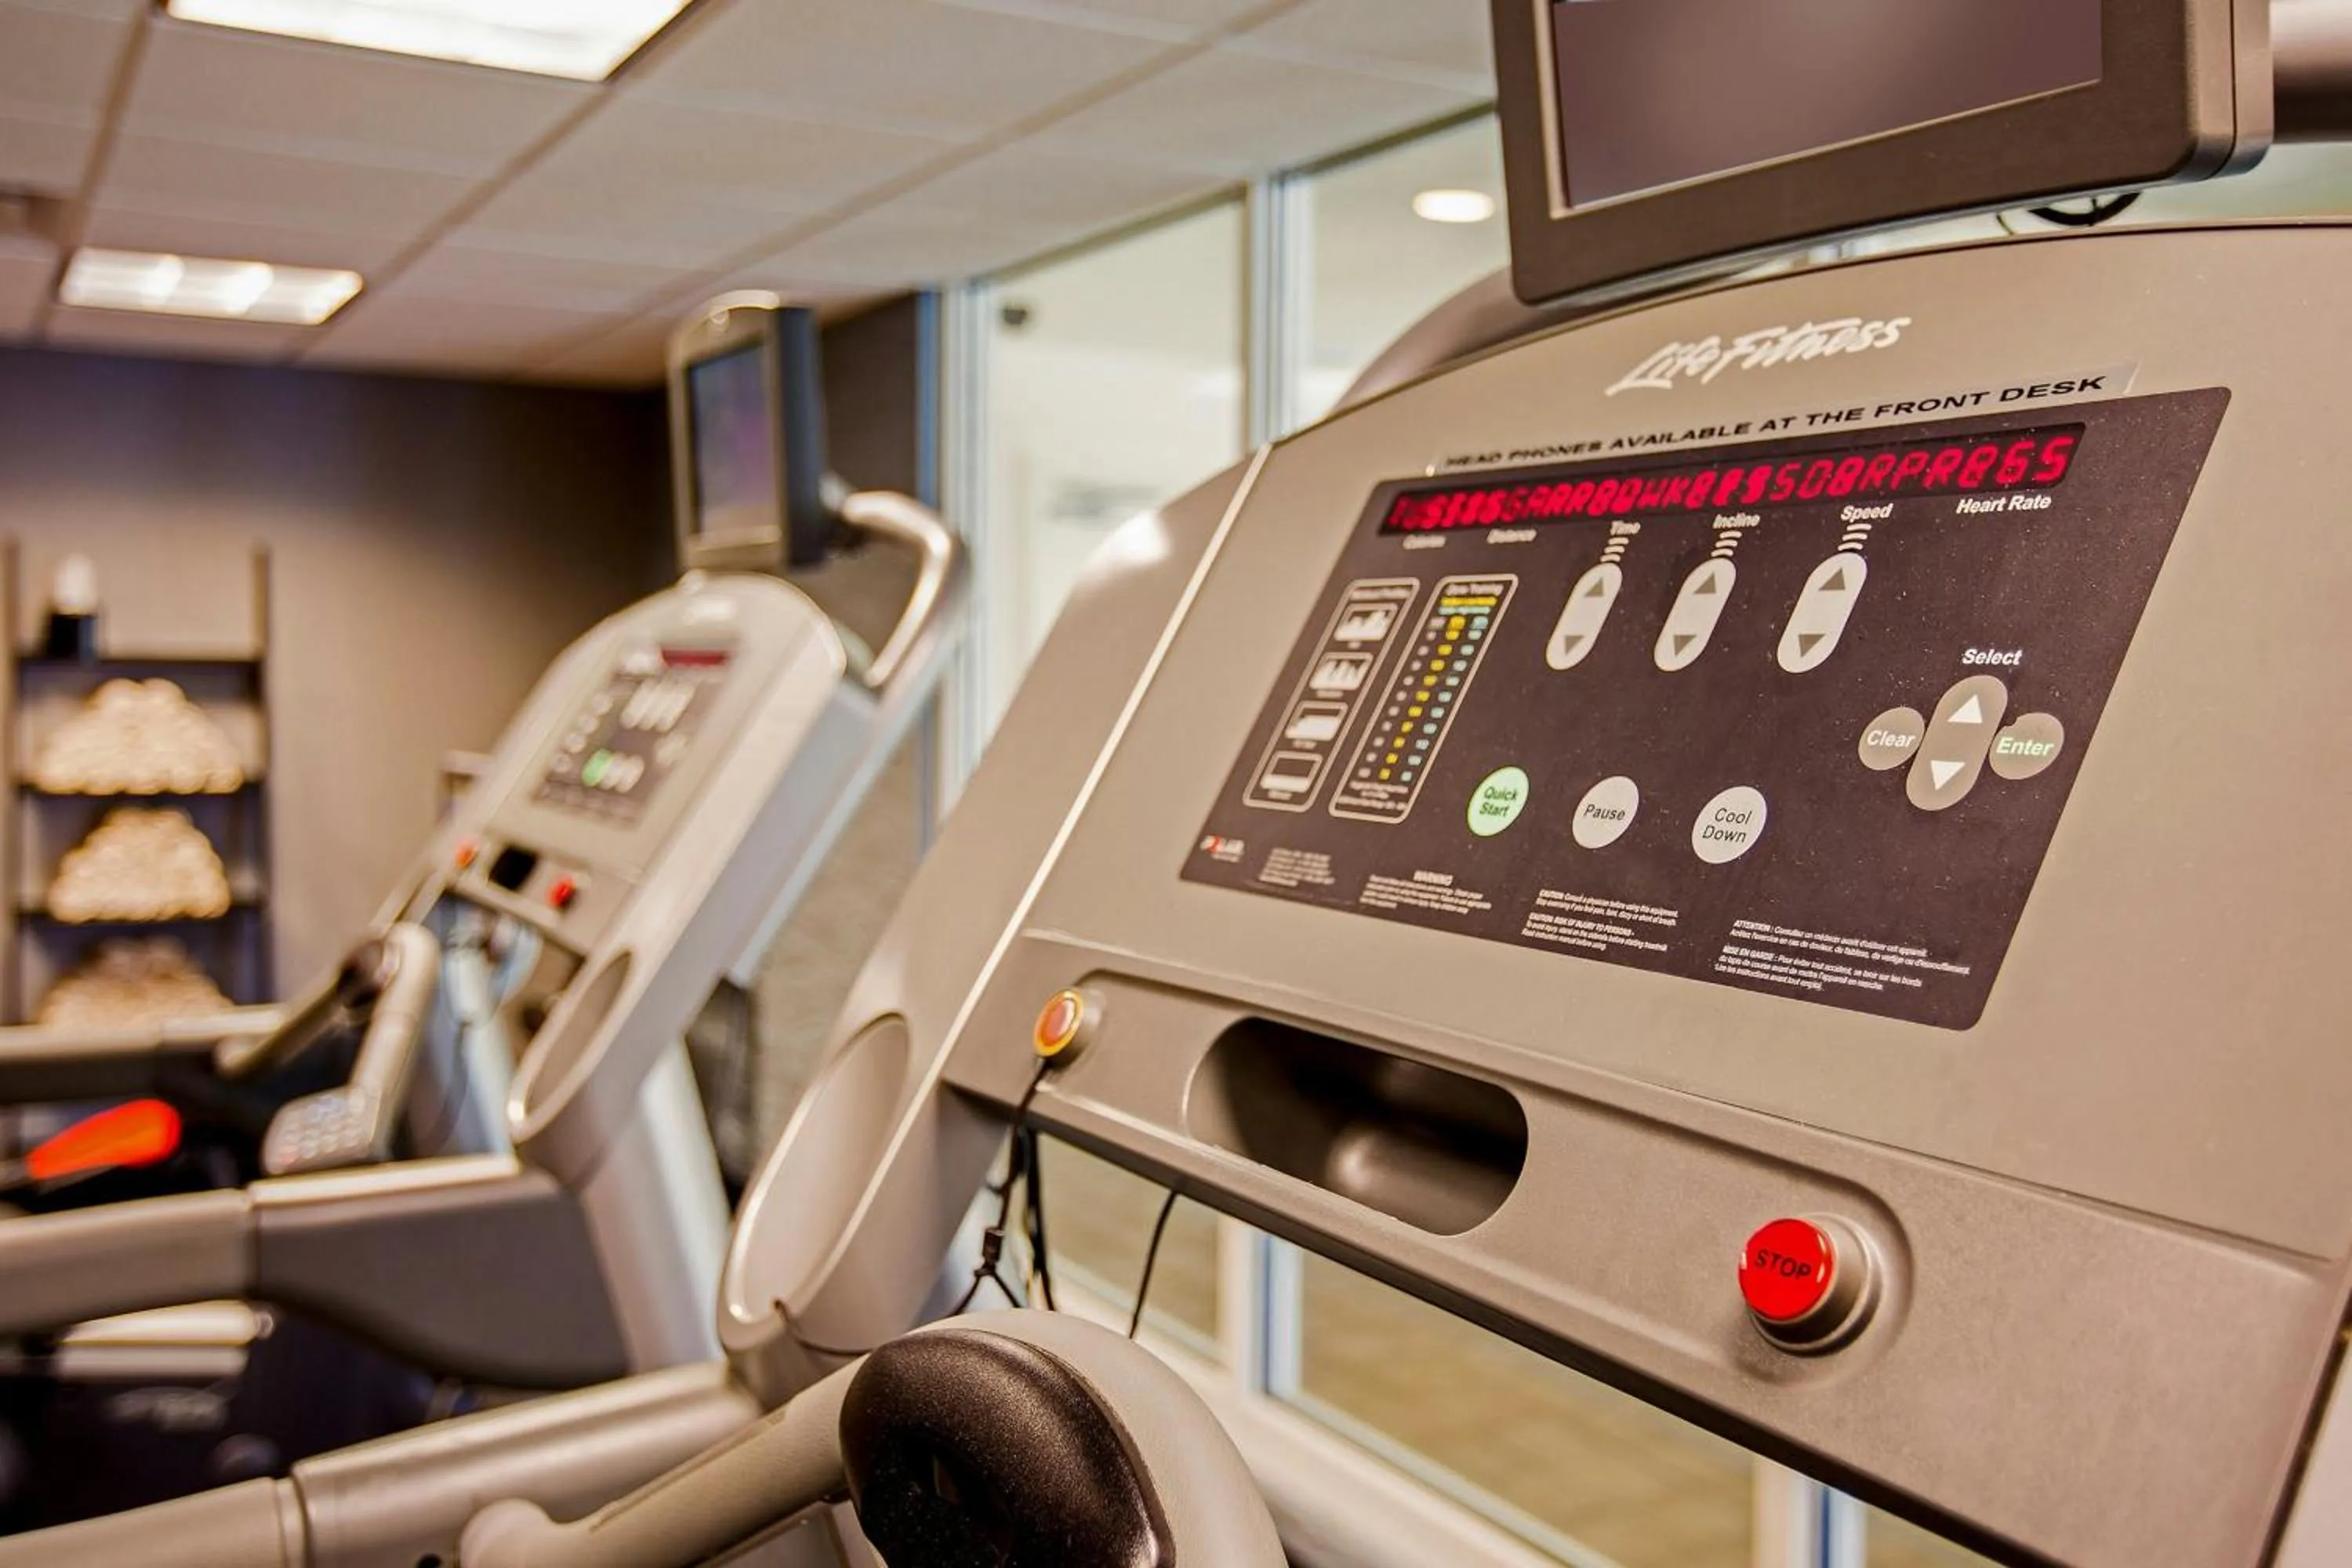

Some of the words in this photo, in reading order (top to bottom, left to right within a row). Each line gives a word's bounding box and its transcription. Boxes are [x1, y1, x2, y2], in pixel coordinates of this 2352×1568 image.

[1508, 441, 1602, 461] PHONES
[1608, 421, 1753, 451] AVAILABLE
[1759, 416, 1798, 433] AT
[1806, 407, 1865, 426] THE
[1874, 391, 1990, 419] FRONT
[1998, 375, 2107, 402] DESK
[1840, 503, 1894, 522] Speed
[1956, 499, 2005, 514] Heart
[2007, 495, 2052, 511] Rate
[1713, 513, 1761, 529] Incline
[1962, 648, 2024, 666] Select
[1867, 730, 1916, 748] Clear
[1995, 737, 2056, 757] Enter
[1483, 786, 1519, 801] Quick
[1479, 802, 1510, 817] Start
[1583, 804, 1627, 822] Pause
[1715, 808, 1753, 825] Cool
[1702, 825, 1748, 844] Down
[1754, 1248, 1812, 1279] STOP
